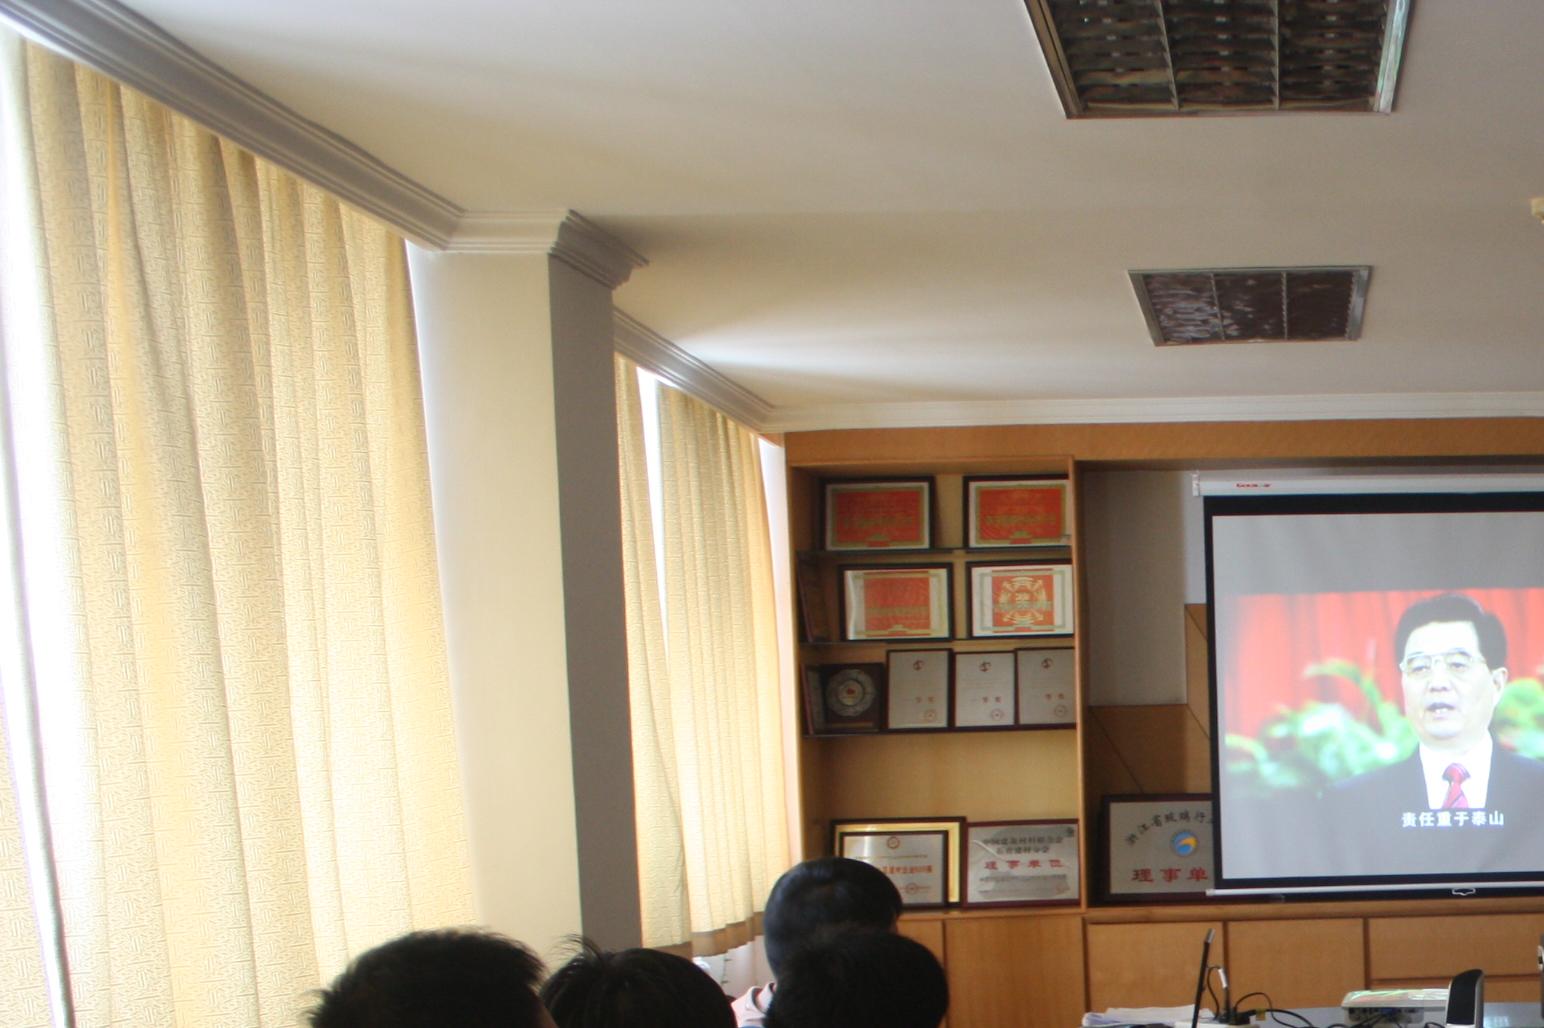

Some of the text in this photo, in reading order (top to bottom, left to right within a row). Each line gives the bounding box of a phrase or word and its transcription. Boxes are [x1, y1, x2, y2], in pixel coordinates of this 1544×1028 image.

[1402, 810, 1504, 828] 责任重于泰山
[984, 859, 1063, 870] 理事单位
